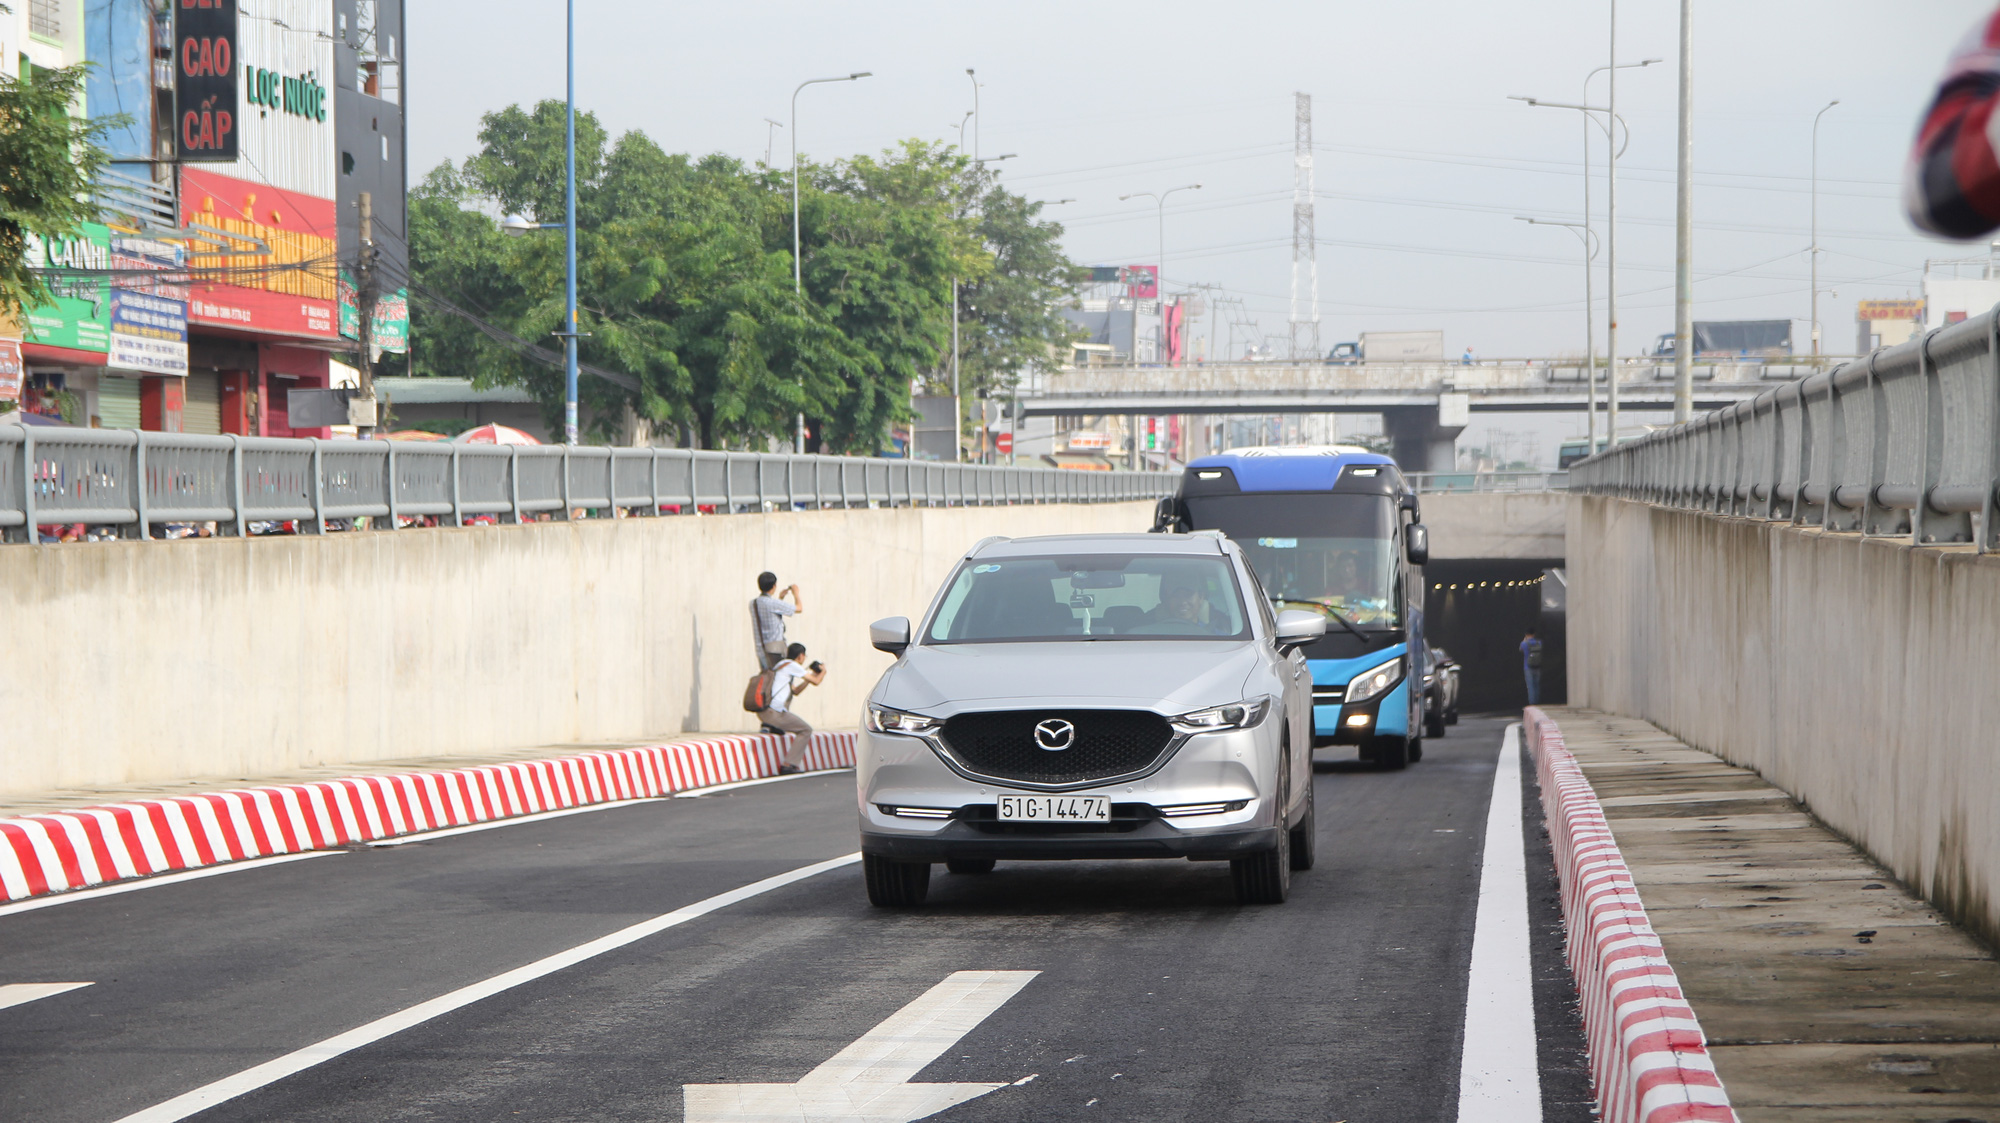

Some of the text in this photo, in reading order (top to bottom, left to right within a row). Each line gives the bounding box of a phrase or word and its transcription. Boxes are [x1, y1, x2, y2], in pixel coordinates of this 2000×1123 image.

[182, 36, 231, 78] CAO
[246, 65, 327, 124] LỌC NƯỚC
[182, 94, 232, 150] CẤP
[1002, 798, 1106, 819] 51G-144.74
